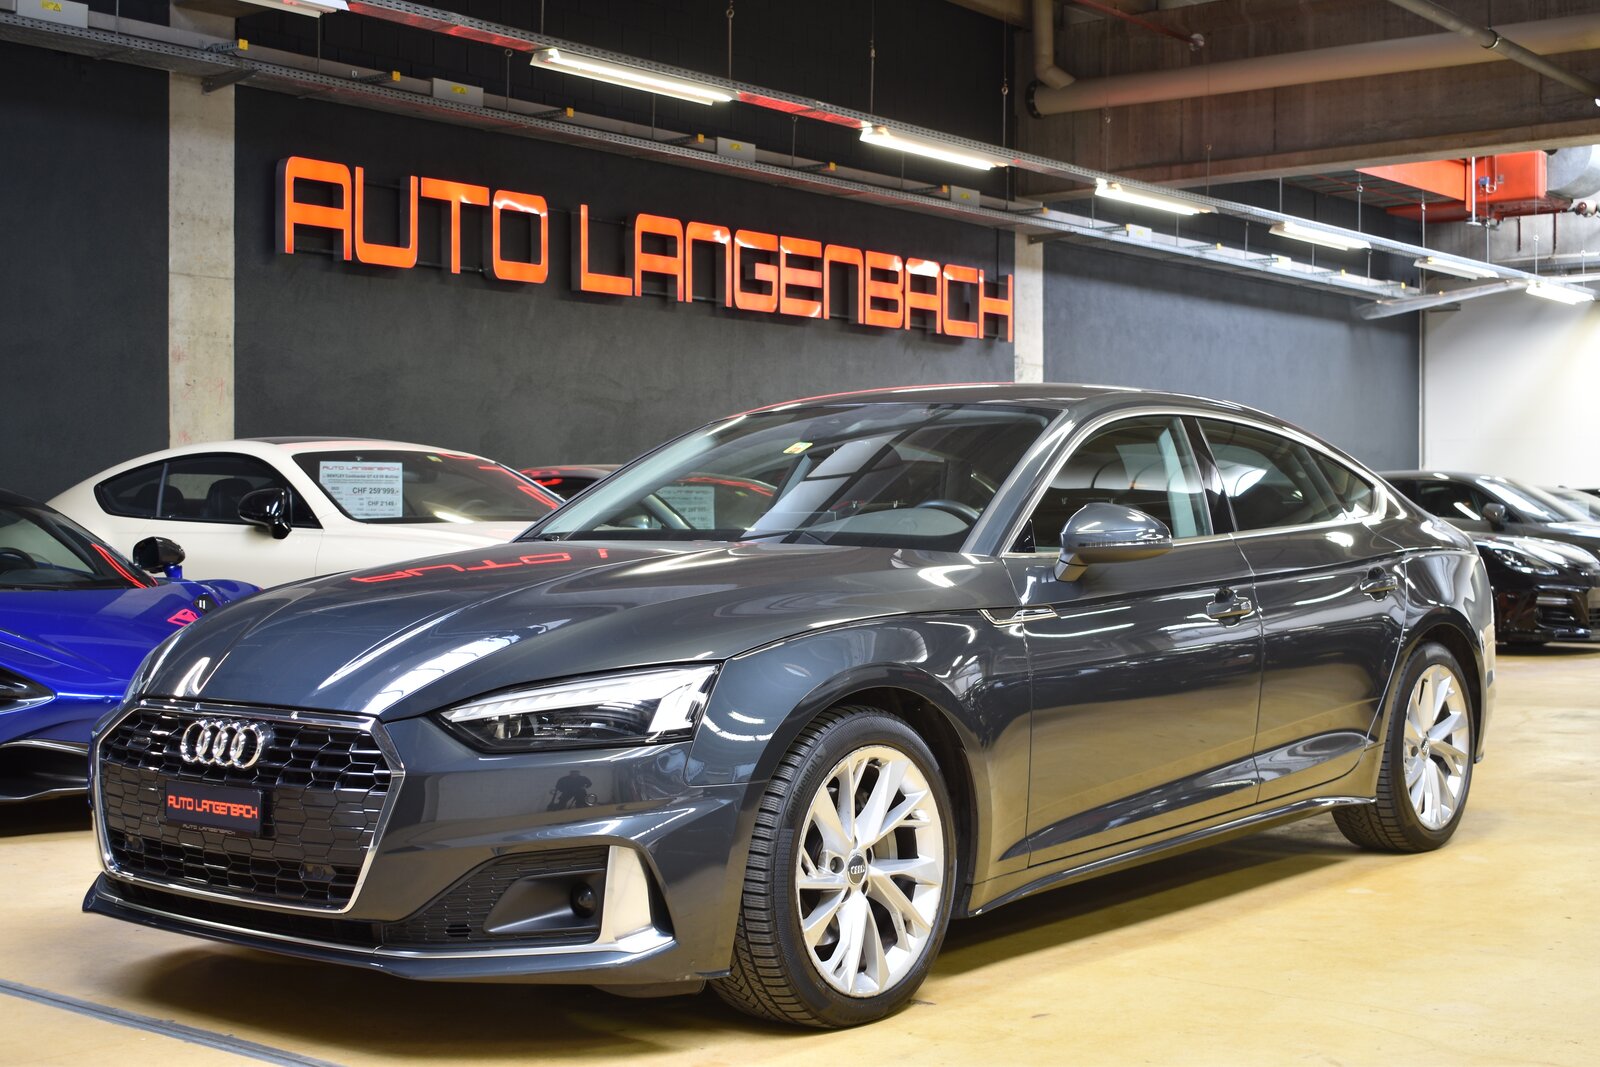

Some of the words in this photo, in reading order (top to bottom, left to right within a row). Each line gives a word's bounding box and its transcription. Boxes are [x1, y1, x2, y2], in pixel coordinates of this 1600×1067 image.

[284, 156, 548, 284] AUTO
[580, 205, 1015, 343] LANGENBACH
[168, 795, 194, 811] AUTO
[195, 799, 258, 820] LANGENBACH
[182, 823, 197, 831] AUTO
